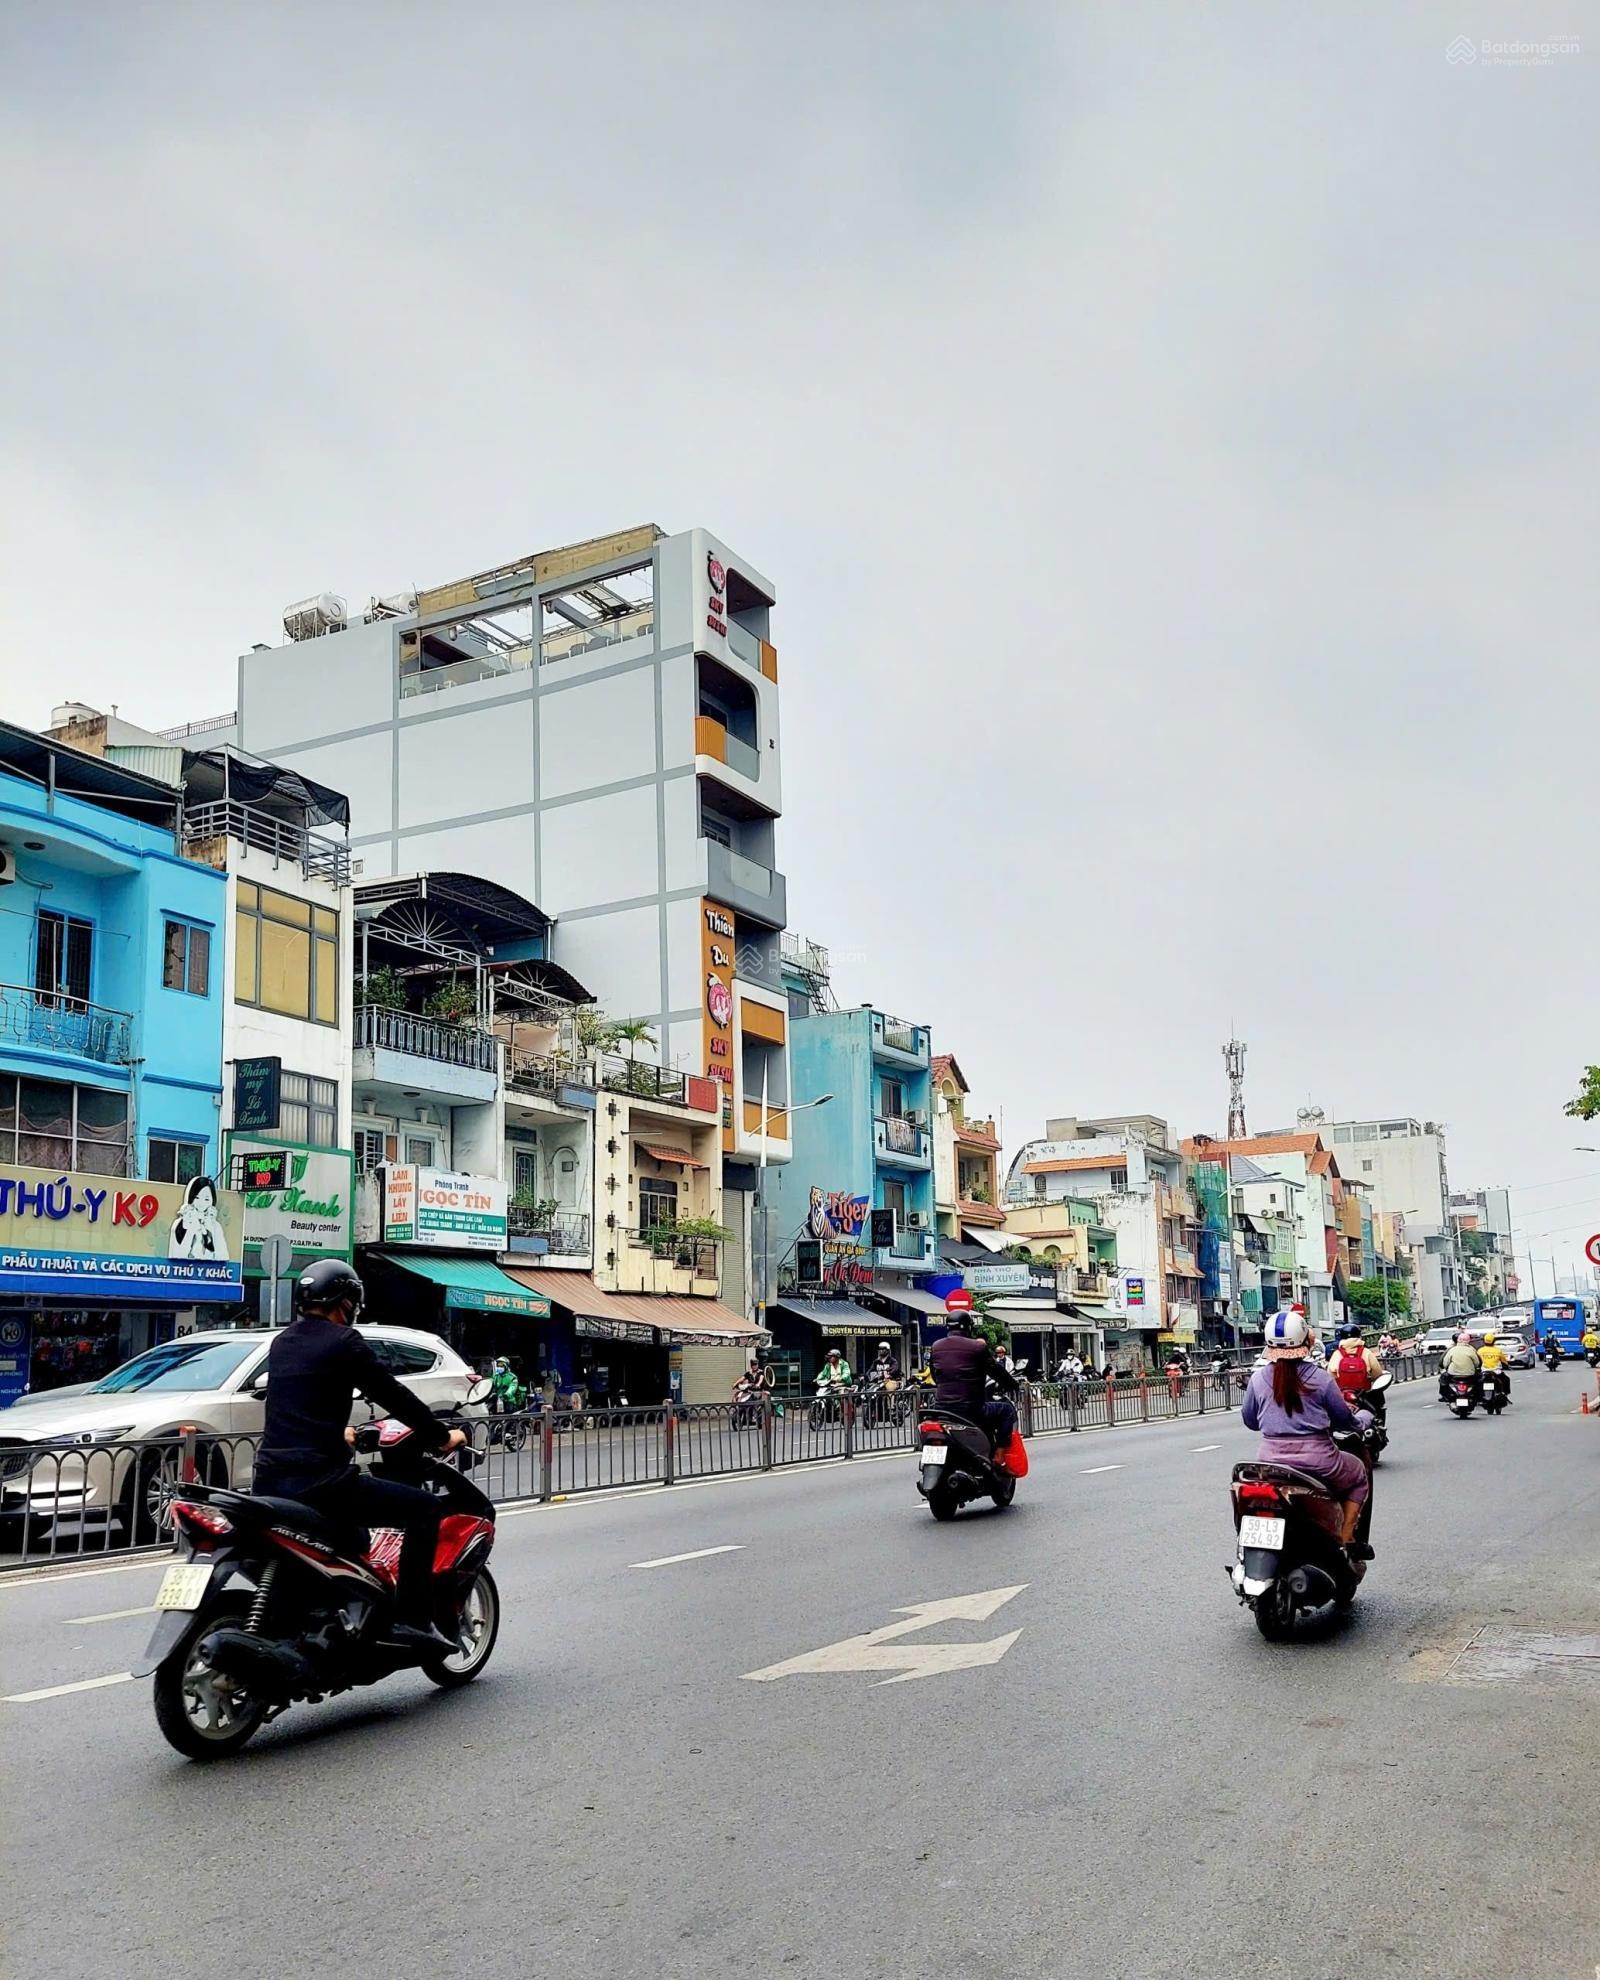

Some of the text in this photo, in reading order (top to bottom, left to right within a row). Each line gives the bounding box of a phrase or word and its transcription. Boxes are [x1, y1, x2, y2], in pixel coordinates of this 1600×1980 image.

[710, 1036, 730, 1057] SKY
[248, 1156, 281, 1173] THÚ-Y
[255, 1173, 271, 1186] K9
[388, 1182, 412, 1194] KHUNG
[0, 1176, 160, 1227] THÚ-Y K9
[827, 1191, 868, 1233] Tiger
[290, 1220, 342, 1233] Beauty center
[2, 1251, 233, 1280] PHẪU THUẬT VÀ CÁC DỊCH VỤ THÚ Y KHÁC
[996, 1271, 1025, 1283] XUYÊN
[853, 1326, 866, 1335] CÁC
[1248, 1518, 1279, 1533] 59-L3
[1243, 1532, 1280, 1547] 254.92
